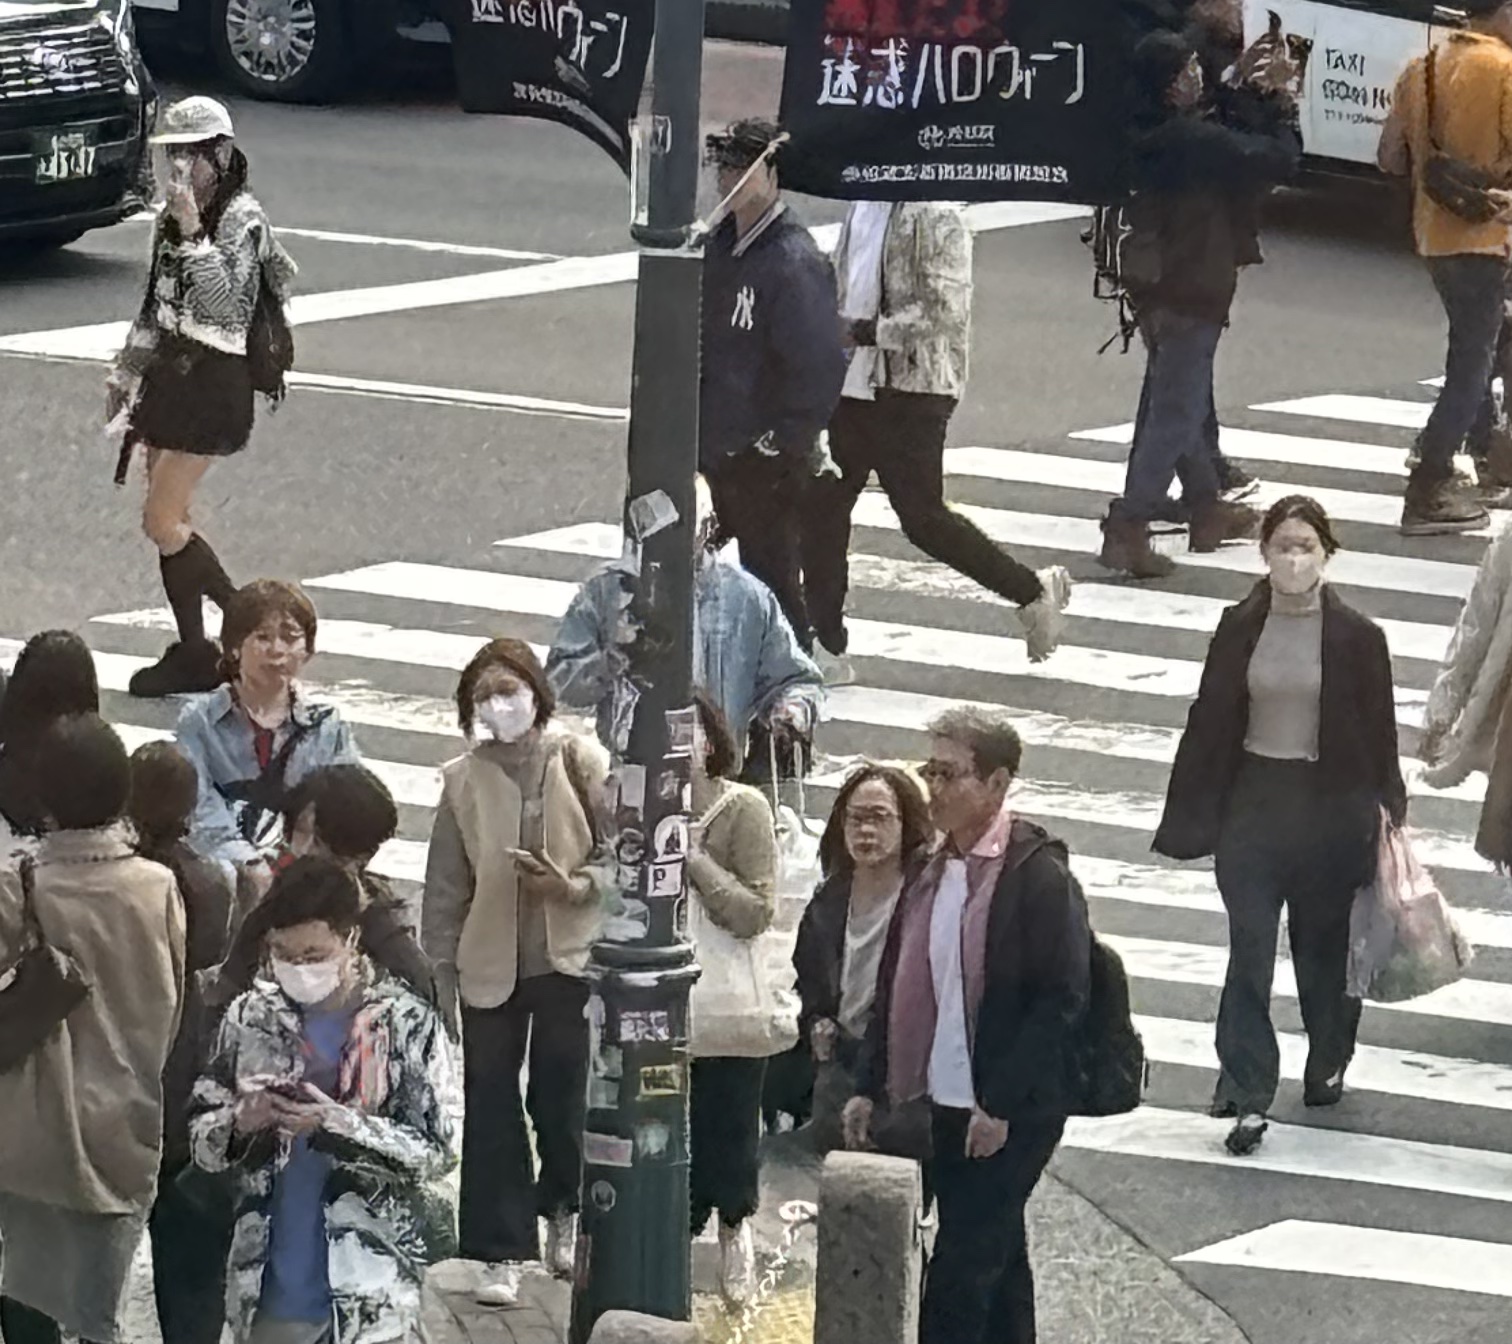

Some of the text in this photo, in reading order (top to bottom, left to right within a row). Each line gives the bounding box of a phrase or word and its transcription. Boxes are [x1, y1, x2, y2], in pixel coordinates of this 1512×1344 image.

[816, 33, 1085, 110] 迷惑ハロウィーン
[1325, 46, 1366, 77] TAXI
